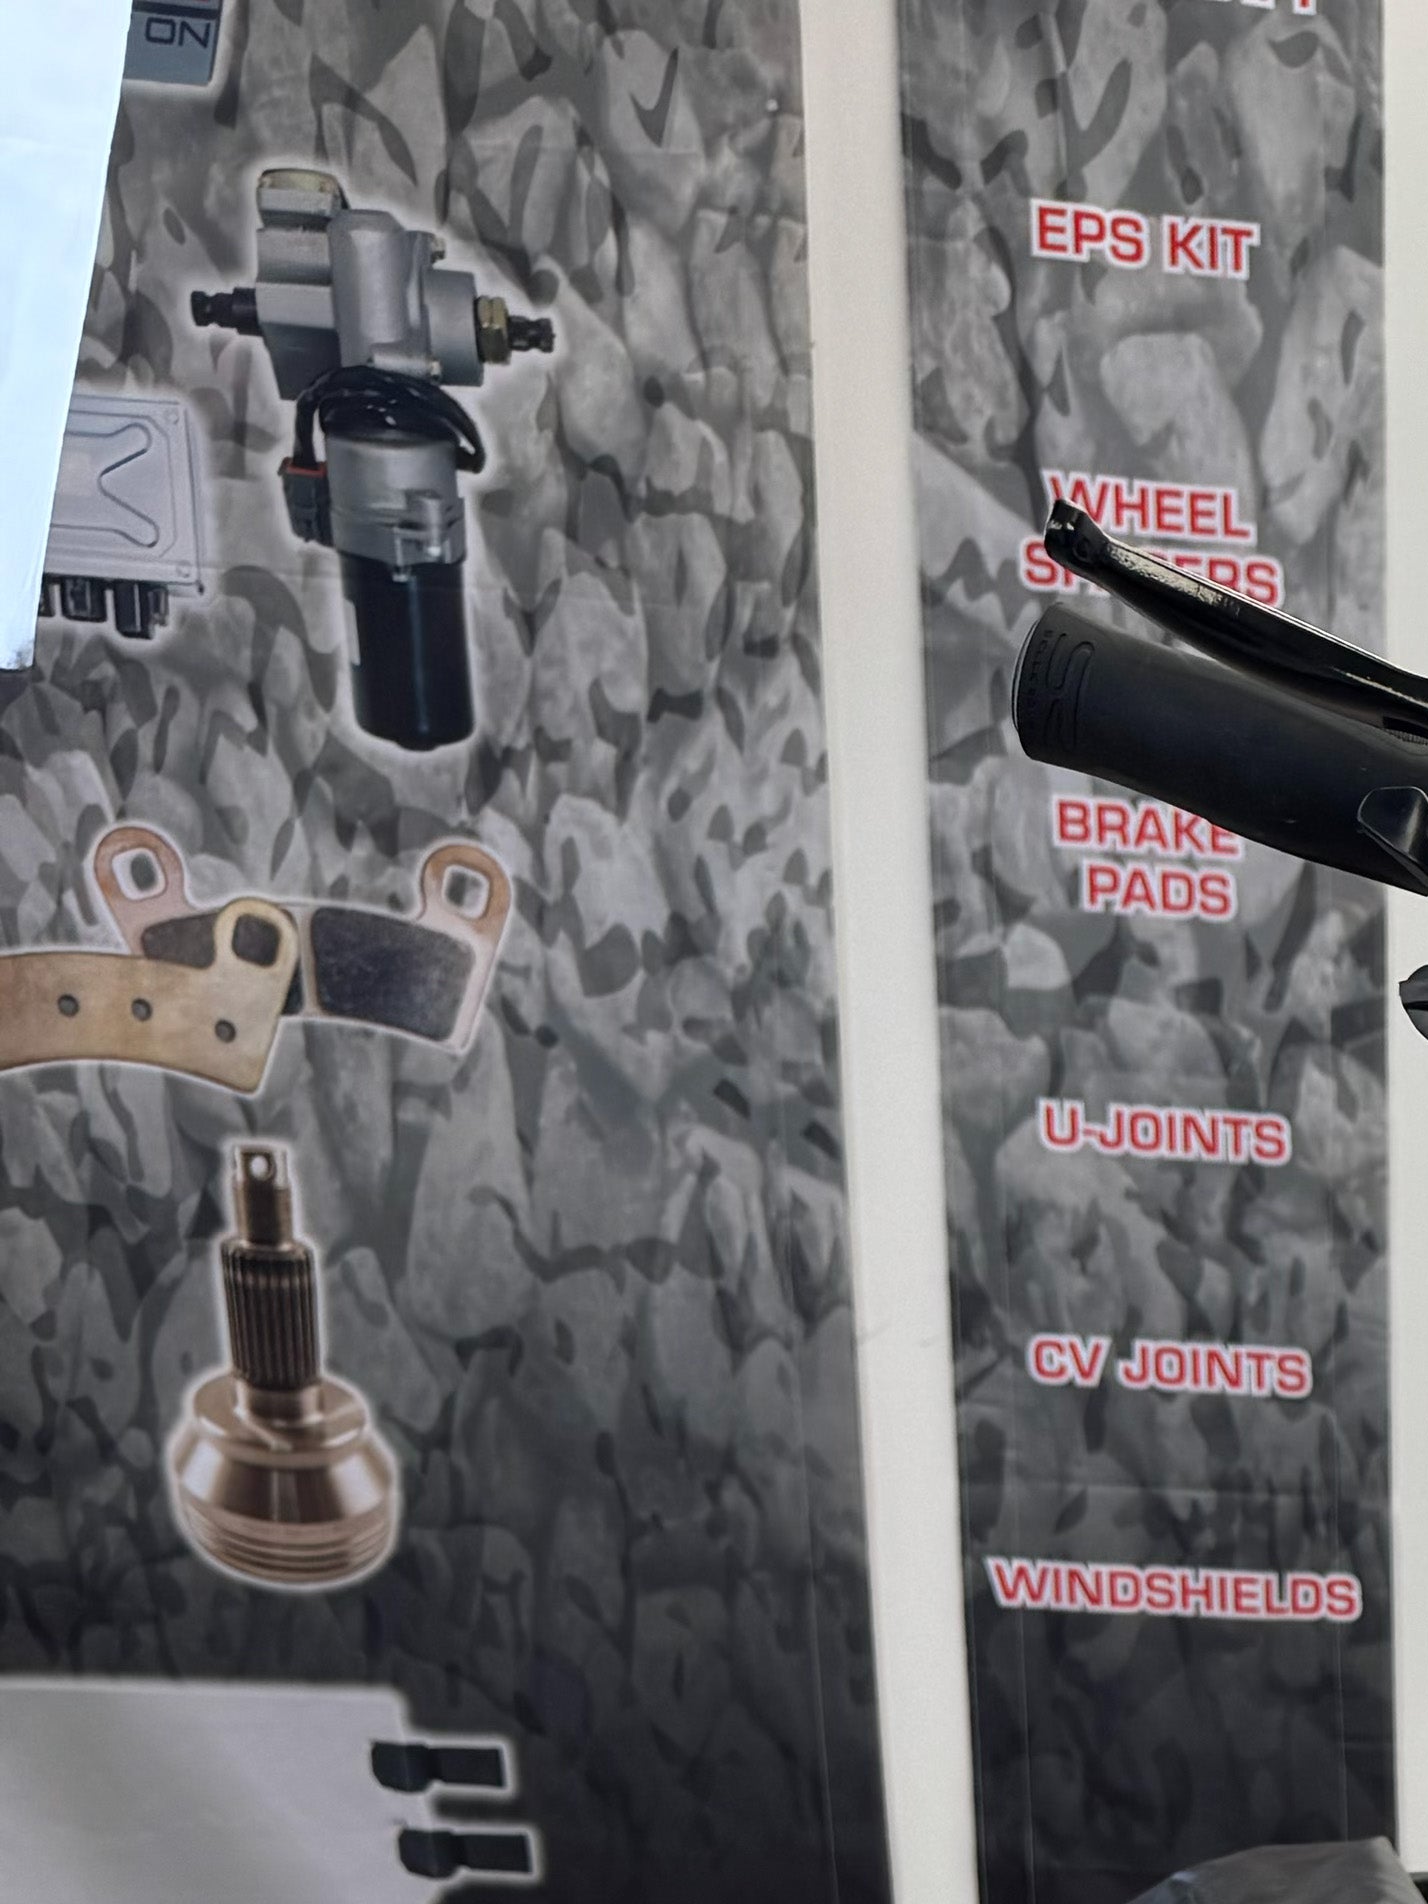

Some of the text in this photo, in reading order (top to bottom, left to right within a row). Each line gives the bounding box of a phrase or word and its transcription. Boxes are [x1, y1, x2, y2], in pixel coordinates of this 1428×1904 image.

[1034, 202, 1257, 276] EPS KIT
[1046, 473, 1252, 543] WHEEL
[1055, 797, 1239, 857] BRAKE
[1085, 863, 1233, 920] PADS
[1043, 1103, 1289, 1162] U-JOINTS
[1032, 1337, 1310, 1396] CV JOINTS
[992, 1561, 1361, 1620] WINDSHIELDS
